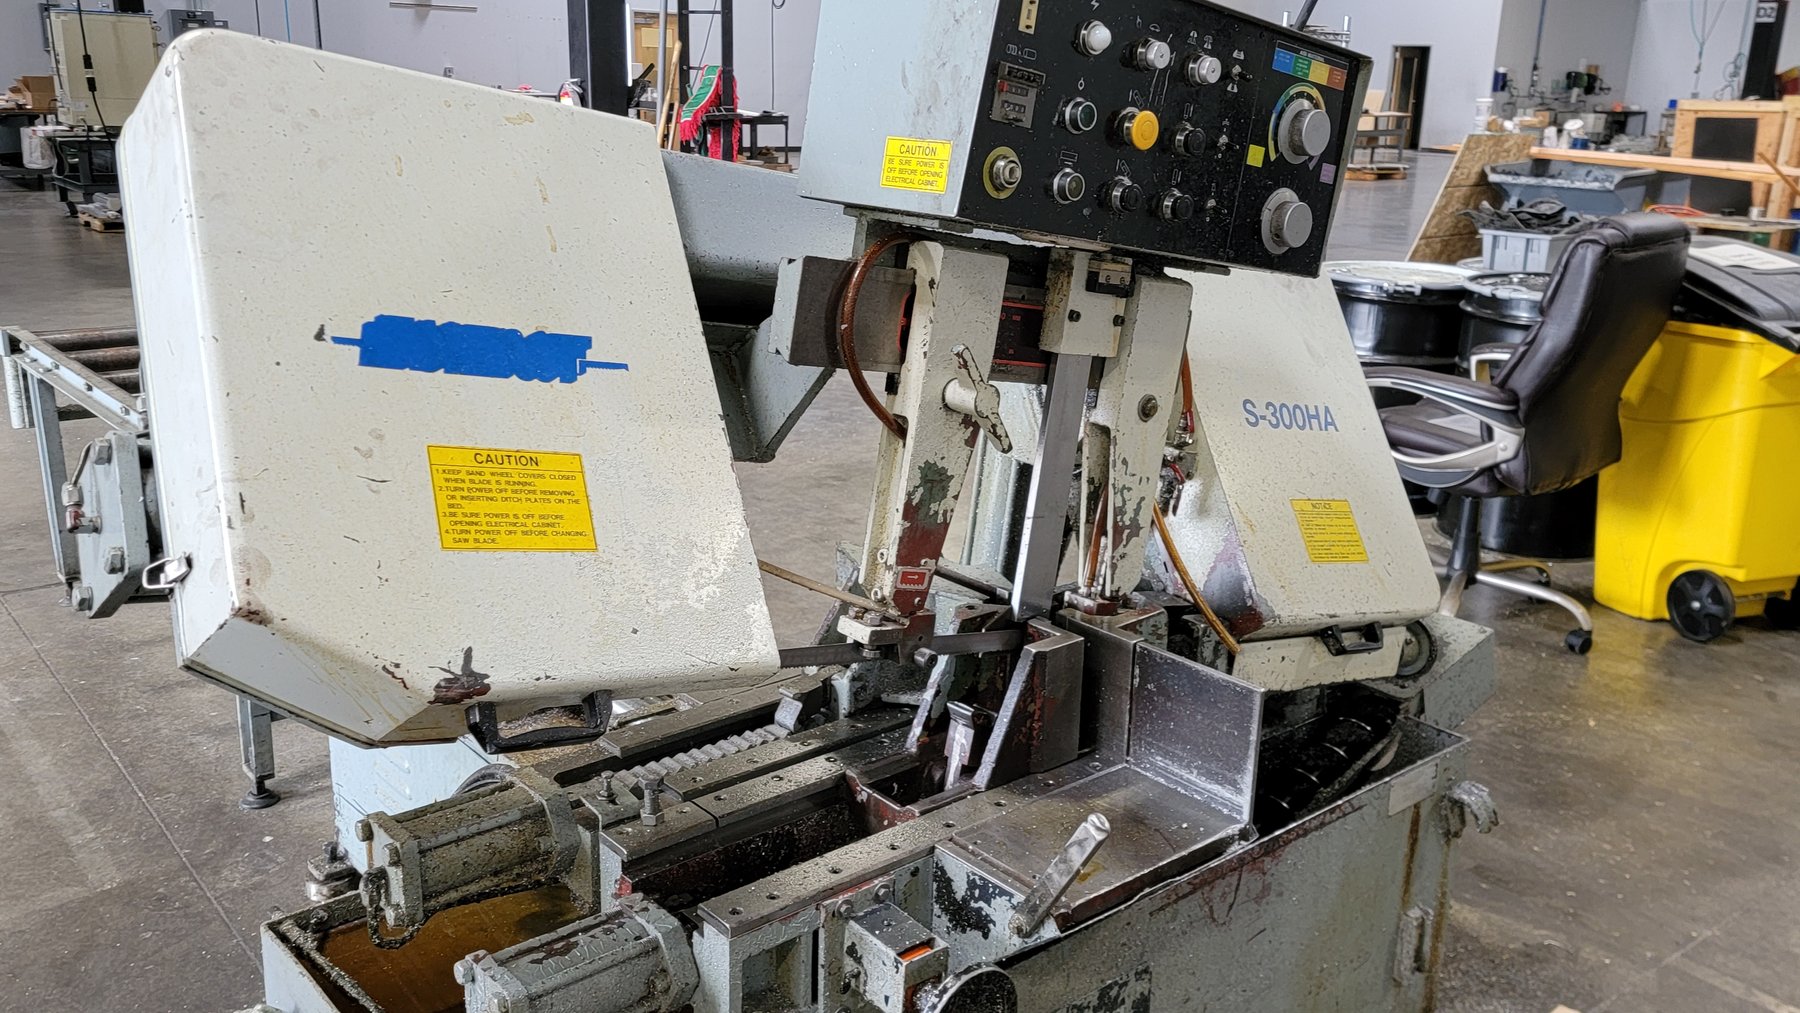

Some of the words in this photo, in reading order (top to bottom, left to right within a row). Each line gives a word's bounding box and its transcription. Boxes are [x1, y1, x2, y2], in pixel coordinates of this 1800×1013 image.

[900, 144, 937, 156] CAUTION
[886, 176, 915, 184] ELECTRICAL
[920, 170, 943, 178] OPENING
[1242, 399, 1339, 432] S-300HA
[474, 453, 539, 466] CAUTION
